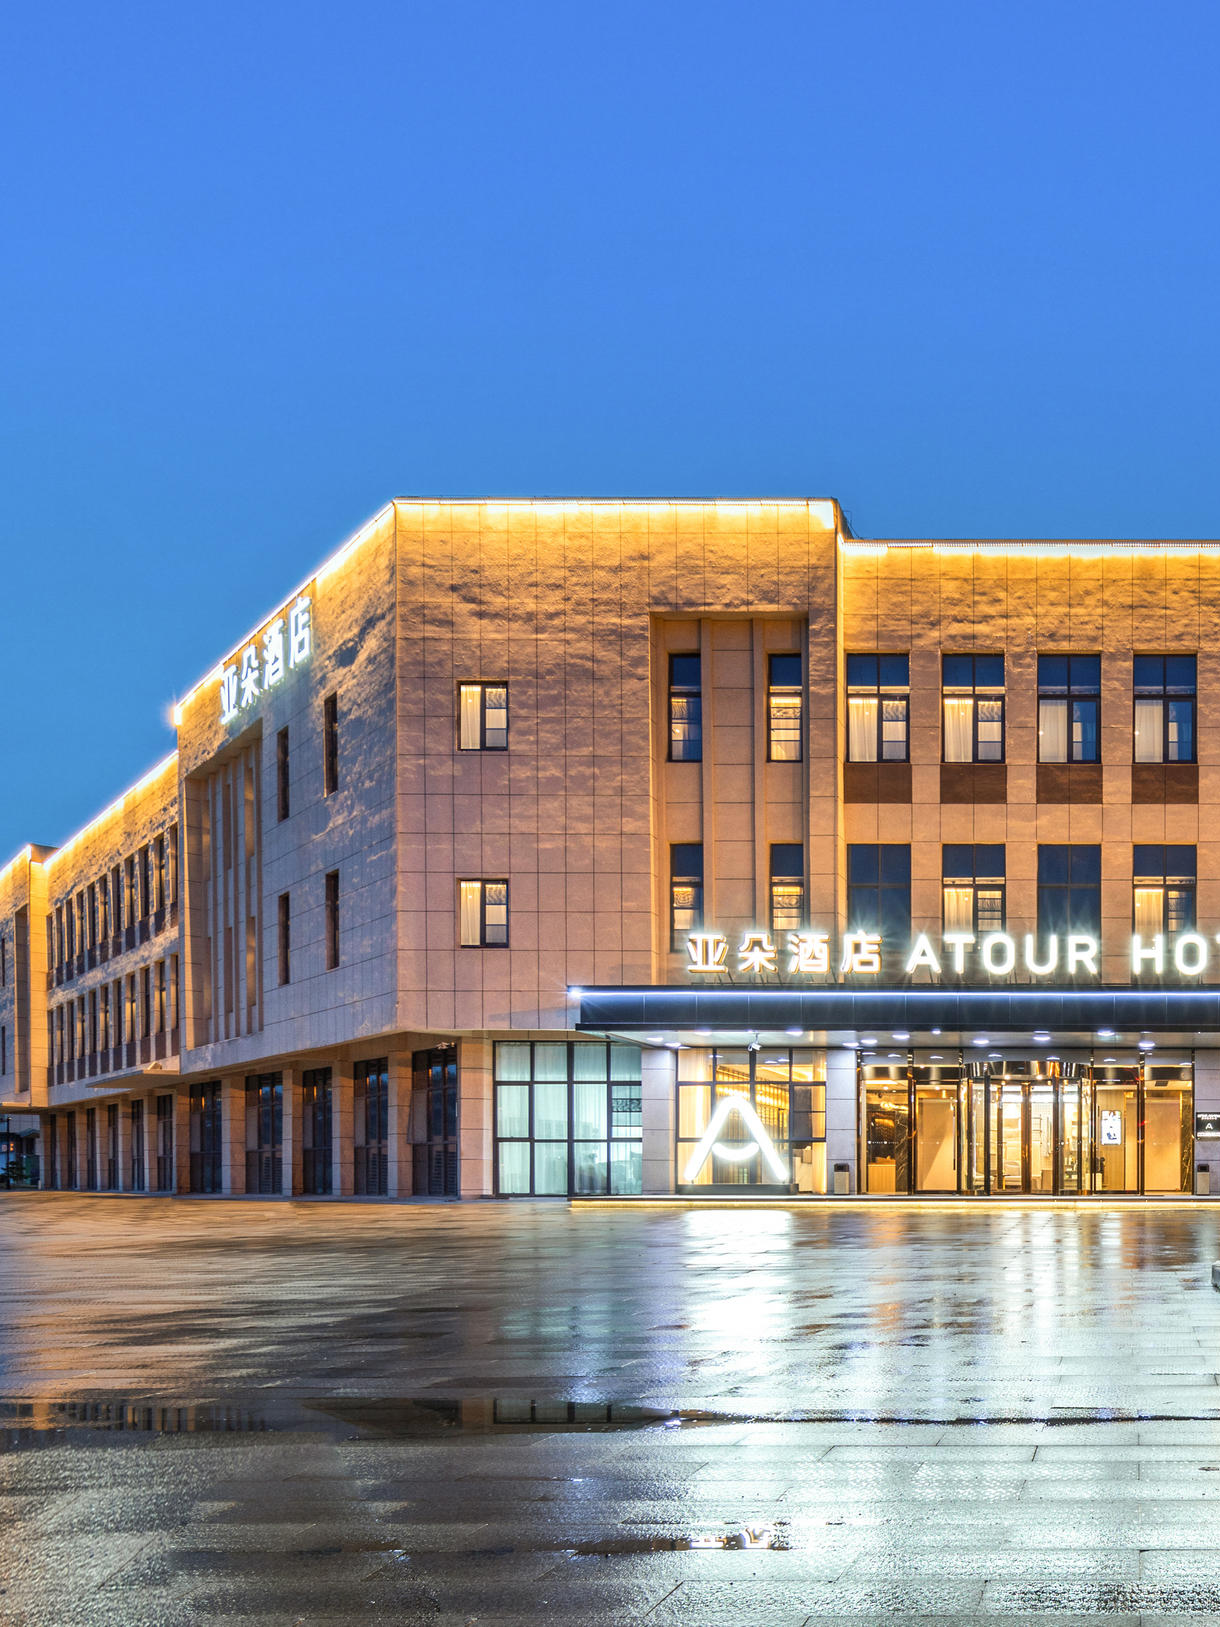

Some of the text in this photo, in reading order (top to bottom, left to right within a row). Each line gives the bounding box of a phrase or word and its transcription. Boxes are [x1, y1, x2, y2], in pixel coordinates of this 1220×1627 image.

[220, 596, 313, 725] 亚朵酒店
[687, 930, 883, 974] 亚朵酒店
[905, 933, 1098, 975] ATOUR
